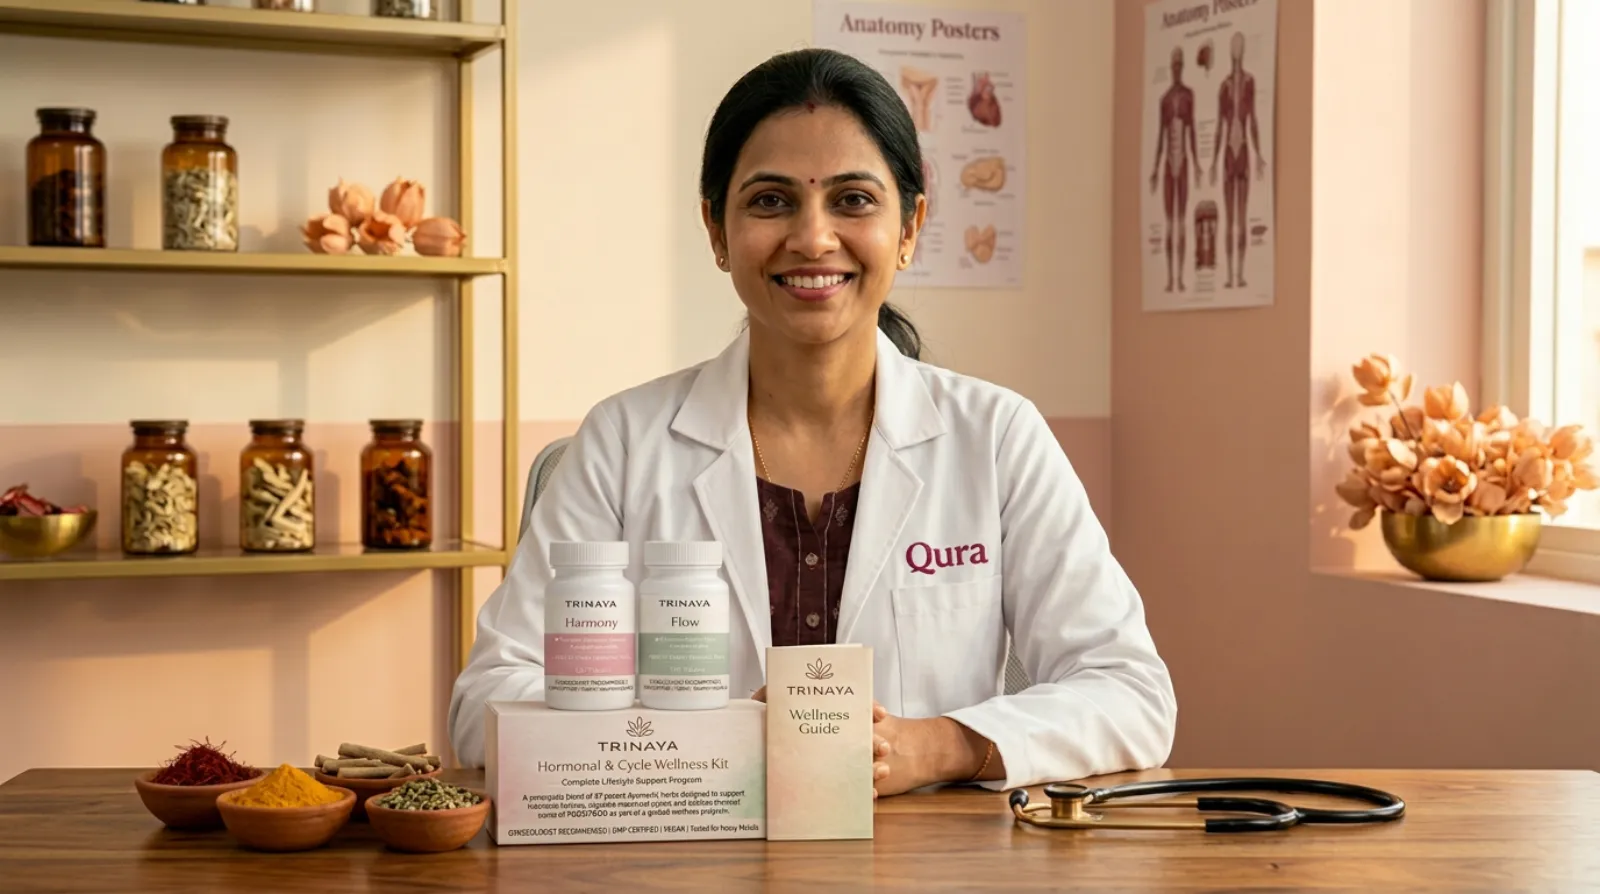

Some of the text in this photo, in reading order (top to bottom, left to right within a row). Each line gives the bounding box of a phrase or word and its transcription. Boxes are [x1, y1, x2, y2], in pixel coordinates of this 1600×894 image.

[840, 13, 1001, 41] Anatomy Posters
[906, 541, 989, 575] Qura
[565, 617, 619, 630] Harmony
[671, 616, 700, 628] Flow
[786, 685, 855, 696] TRINAYA
[789, 708, 850, 721] Wellness
[798, 722, 841, 735] Guide
[597, 740, 679, 752] TRINAYA
[537, 757, 729, 773] Hormonal & Cycle Wellness Kit
[522, 794, 529, 802] A
[586, 792, 594, 800] of
[673, 799, 686, 807] and
